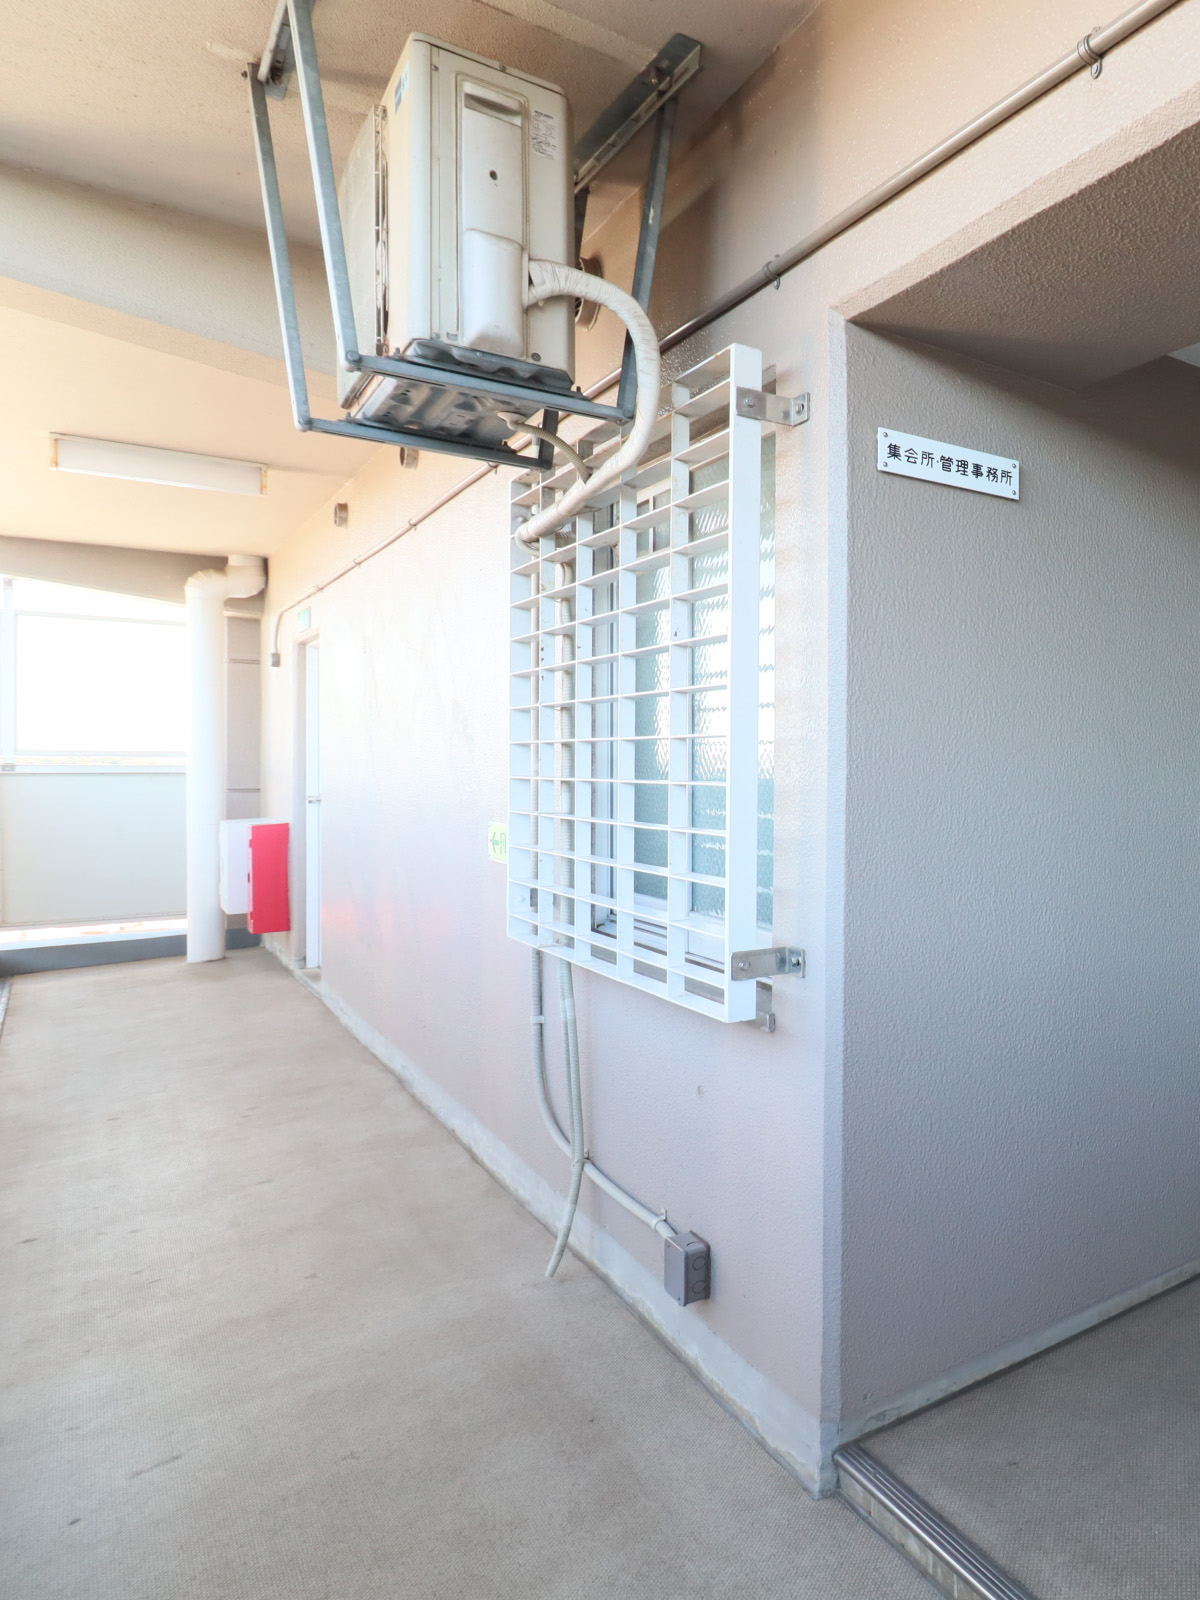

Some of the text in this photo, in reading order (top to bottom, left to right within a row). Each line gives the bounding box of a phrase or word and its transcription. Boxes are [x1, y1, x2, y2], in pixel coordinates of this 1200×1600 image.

[886, 442, 1014, 487] 集会所・管理事務所
